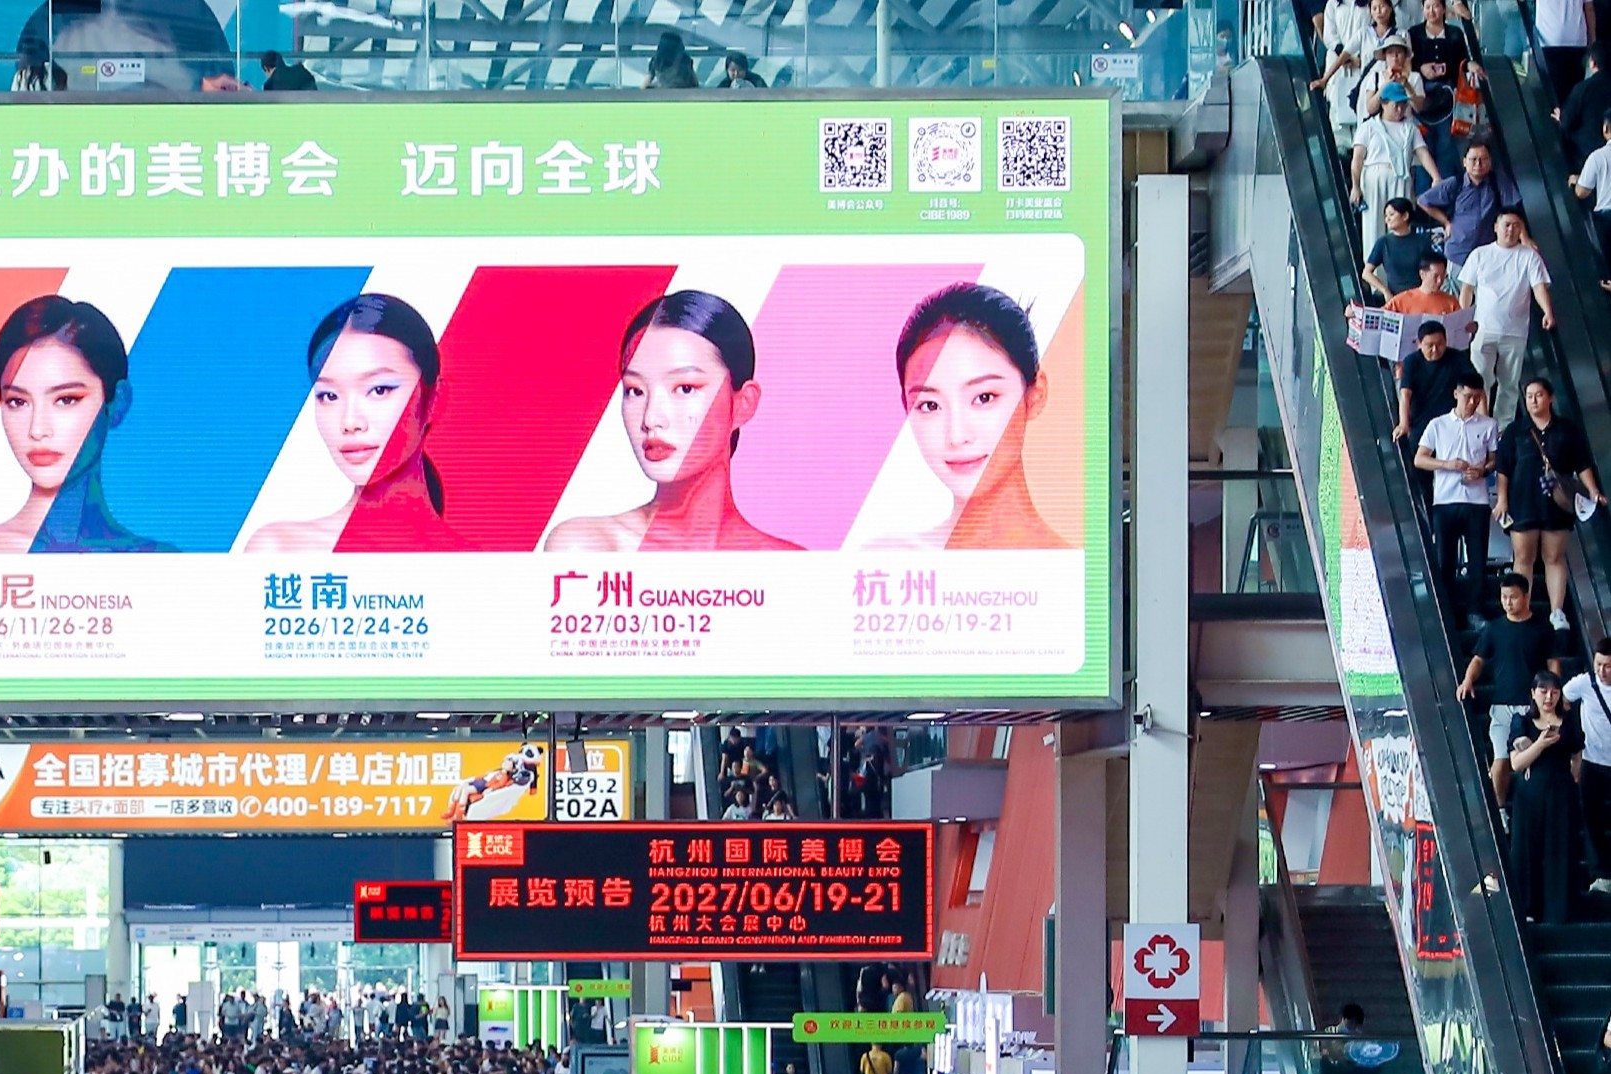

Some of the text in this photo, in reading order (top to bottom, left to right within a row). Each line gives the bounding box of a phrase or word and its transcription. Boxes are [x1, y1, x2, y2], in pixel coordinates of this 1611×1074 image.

[401, 140, 661, 196] 迈向全球
[264, 573, 424, 610] 越南 VIETNAM
[551, 571, 765, 607] 广州 GUANGZHOU
[853, 570, 1038, 606] 杭州 HANGZHOU
[41, 595, 133, 609] INDONESIA
[265, 616, 428, 637] 2026/12/24-26
[551, 615, 711, 635] 2027/03/10-12
[853, 614, 1012, 633] 2027/06/19-21
[33, 752, 462, 787] 全国招募城市代理/单店加盟
[41, 800, 233, 815] 专注头疗+面部 一店多营收
[263, 795, 433, 817] 400-189-7117
[649, 838, 900, 864] 杭州国际美博会
[649, 867, 900, 877] HANGZHOU INTERNATIONAL BEAUTY EXPO
[489, 877, 632, 907] 展览预告
[650, 881, 900, 912] 2027/06/19-21
[649, 915, 806, 932] 杭州大会展中心
